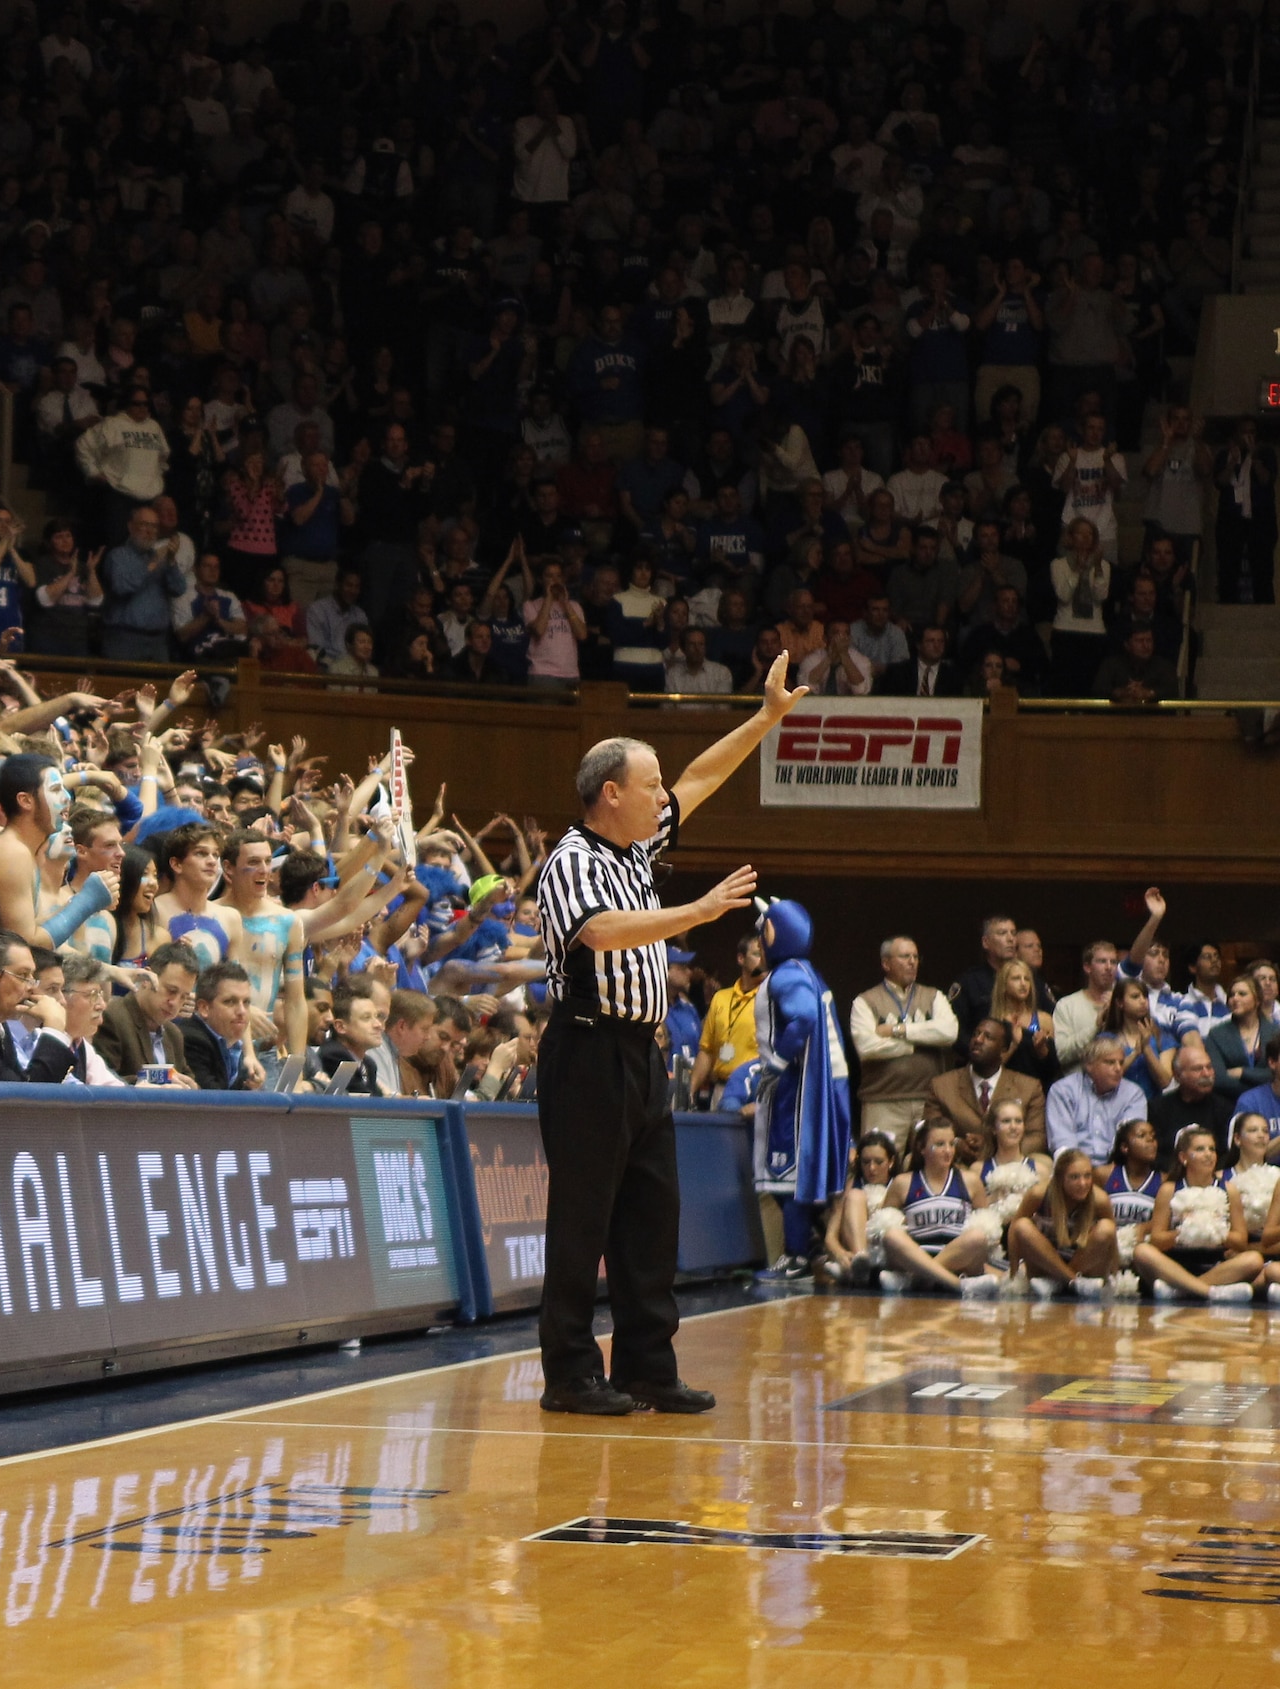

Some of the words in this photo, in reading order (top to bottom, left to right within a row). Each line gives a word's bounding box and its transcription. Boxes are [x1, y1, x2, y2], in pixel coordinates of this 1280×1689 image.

[595, 353, 637, 374] DUKE
[776, 715, 963, 765] ESPN
[775, 765, 793, 784] THE
[796, 766, 858, 786] WORLDWIDE
[861, 767, 898, 786] LEADER
[901, 768, 913, 787] IN
[916, 768, 959, 787] SPORTS
[289, 1178, 355, 1261] ESPN
